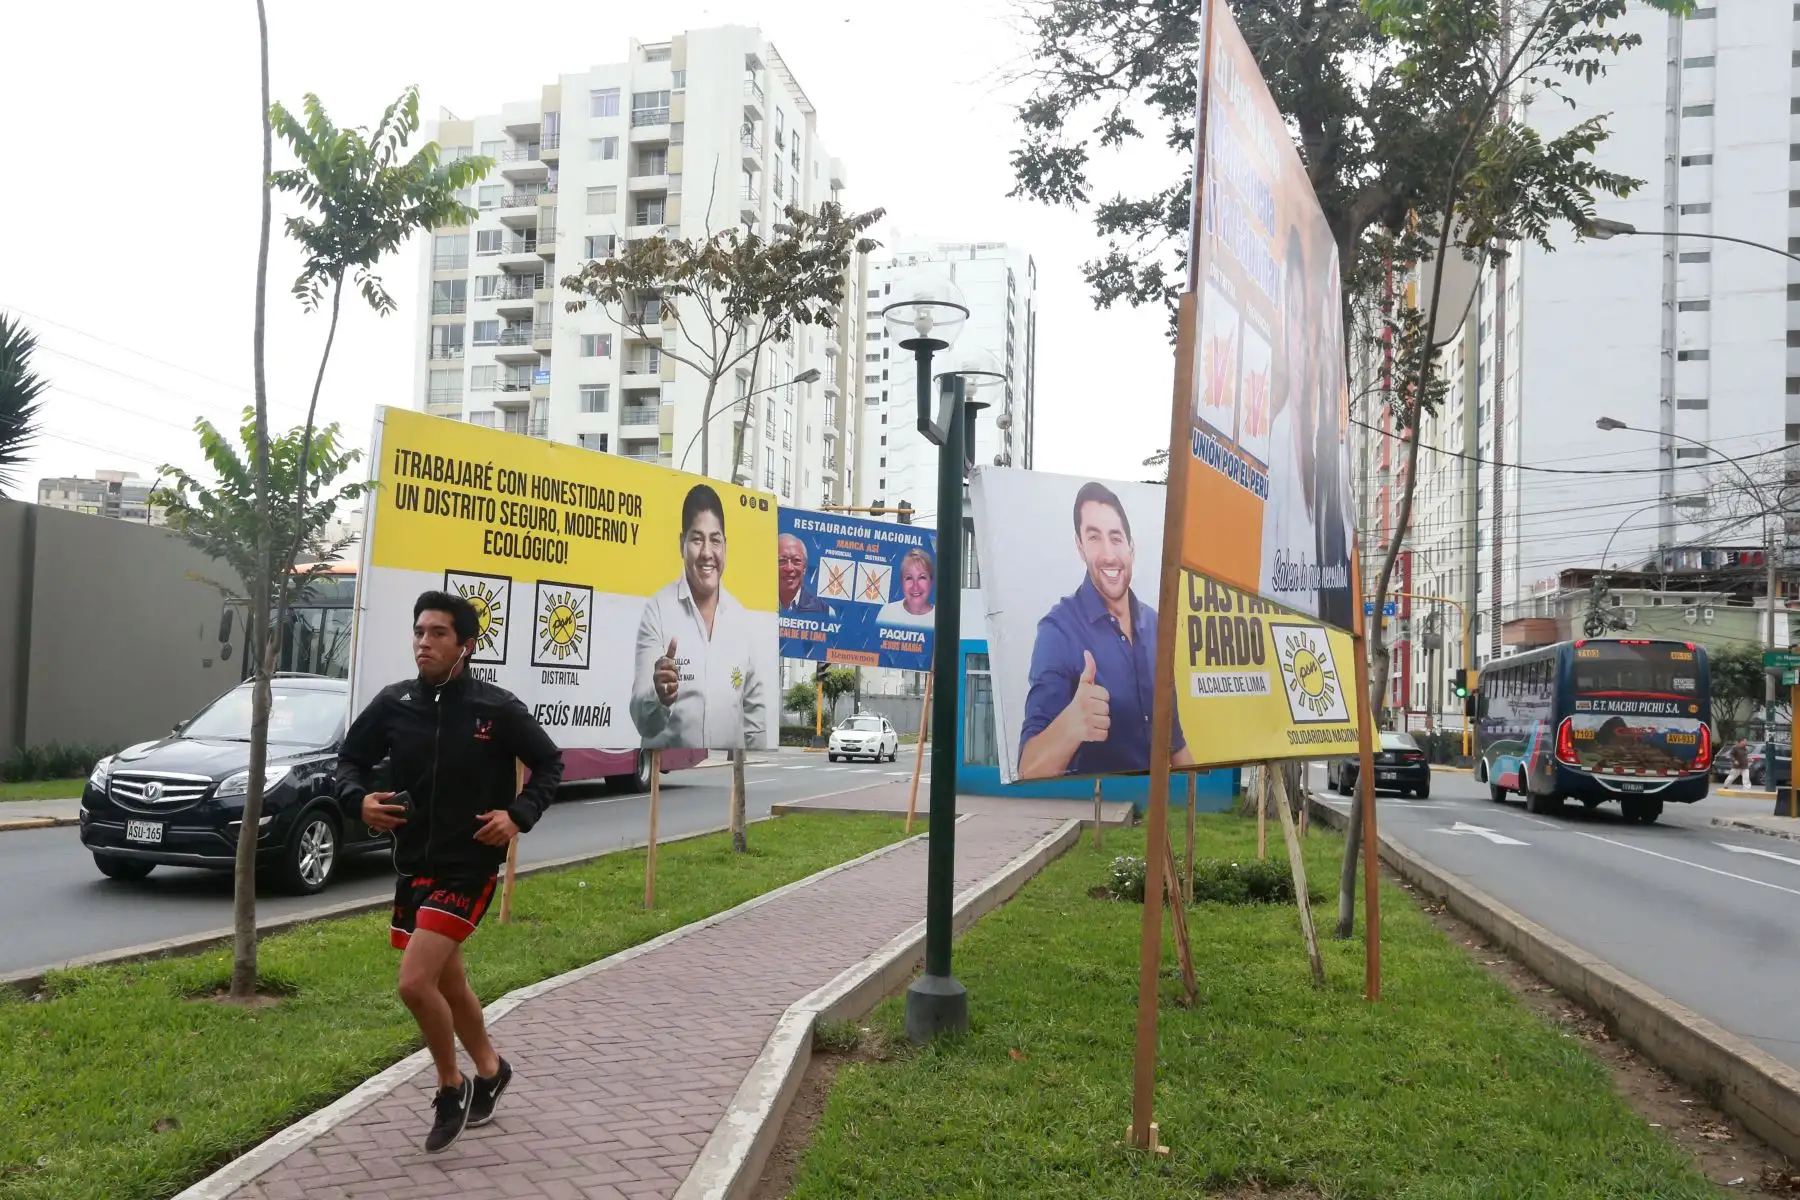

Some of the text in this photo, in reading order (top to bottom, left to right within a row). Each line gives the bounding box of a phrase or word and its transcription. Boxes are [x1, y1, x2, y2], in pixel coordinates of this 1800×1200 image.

[1192, 427, 1269, 501] UNIÓN POR EL PERÚ
[394, 449, 643, 518] ¡TRABAJARÉ CON HONESTIDAD POR
[395, 483, 640, 546] UN DISTRITO SEGURO, MODERNO Y
[794, 518, 923, 546] RESTAURACIÓN NACIONAL
[483, 529, 569, 565] ECOLÓGICO!
[1272, 548, 1299, 593] Saben
[821, 622, 841, 633] LAY
[879, 628, 926, 643] PAQUITA
[1187, 615, 1266, 667] PARDO
[541, 670, 580, 686] DISTRITAL
[1197, 674, 1267, 694] ALCALDE DE LIMA
[572, 702, 612, 727] MARÍA
[1592, 700, 1606, 710] E.T.
[1607, 701, 1637, 712] MACHU
[1638, 702, 1664, 713] PICHU
[1665, 703, 1680, 714] S.A.
[1287, 729, 1332, 745] SOLIDARIDAD
[128, 825, 161, 840] ASU-165
